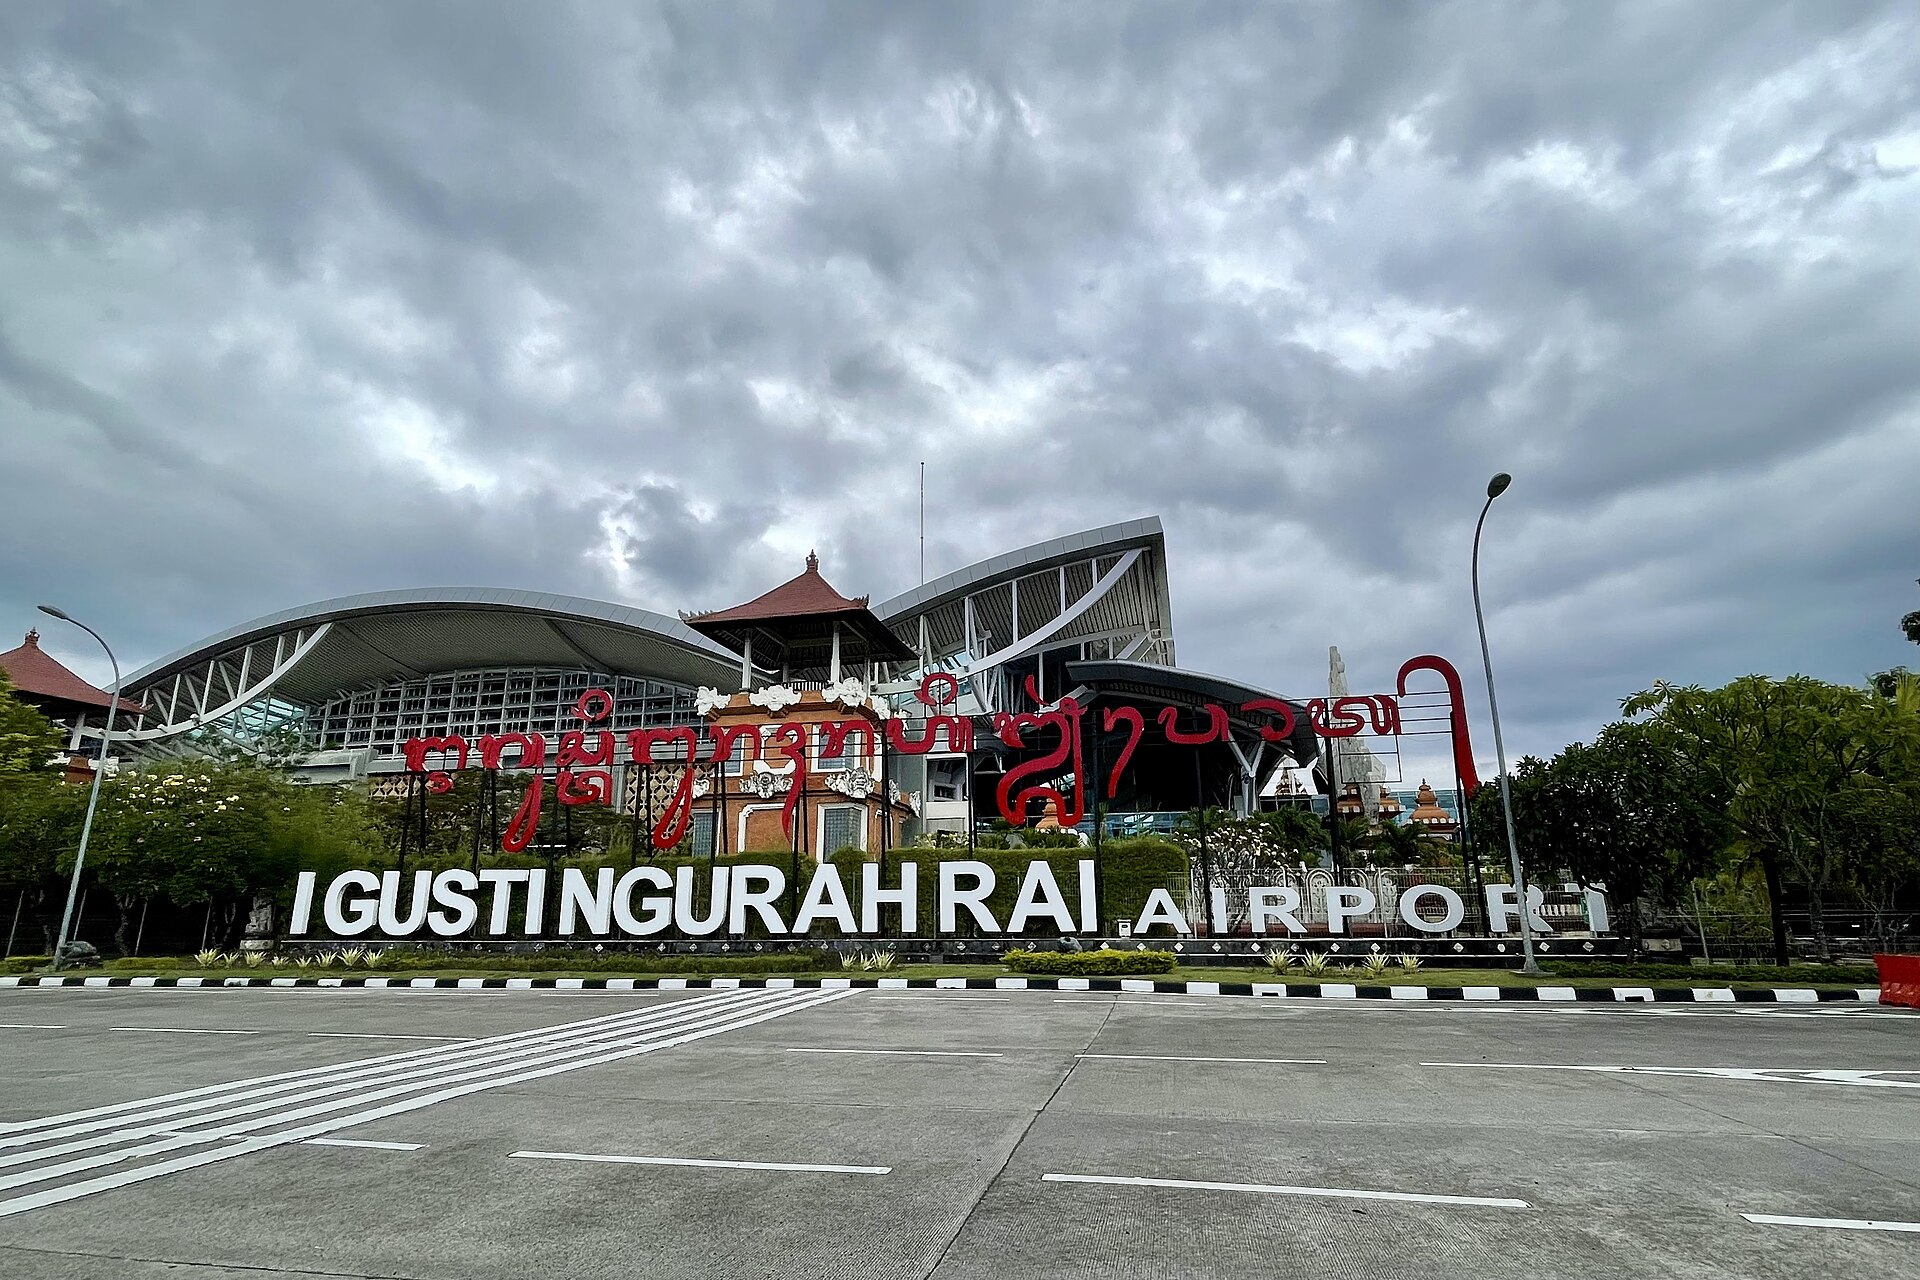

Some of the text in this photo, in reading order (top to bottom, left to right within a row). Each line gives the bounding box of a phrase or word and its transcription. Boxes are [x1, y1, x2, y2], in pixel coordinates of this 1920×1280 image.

[289, 871, 317, 935] I
[323, 868, 548, 936] GUSTI
[557, 862, 919, 936] NGURAH
[938, 859, 1098, 934] RAI
